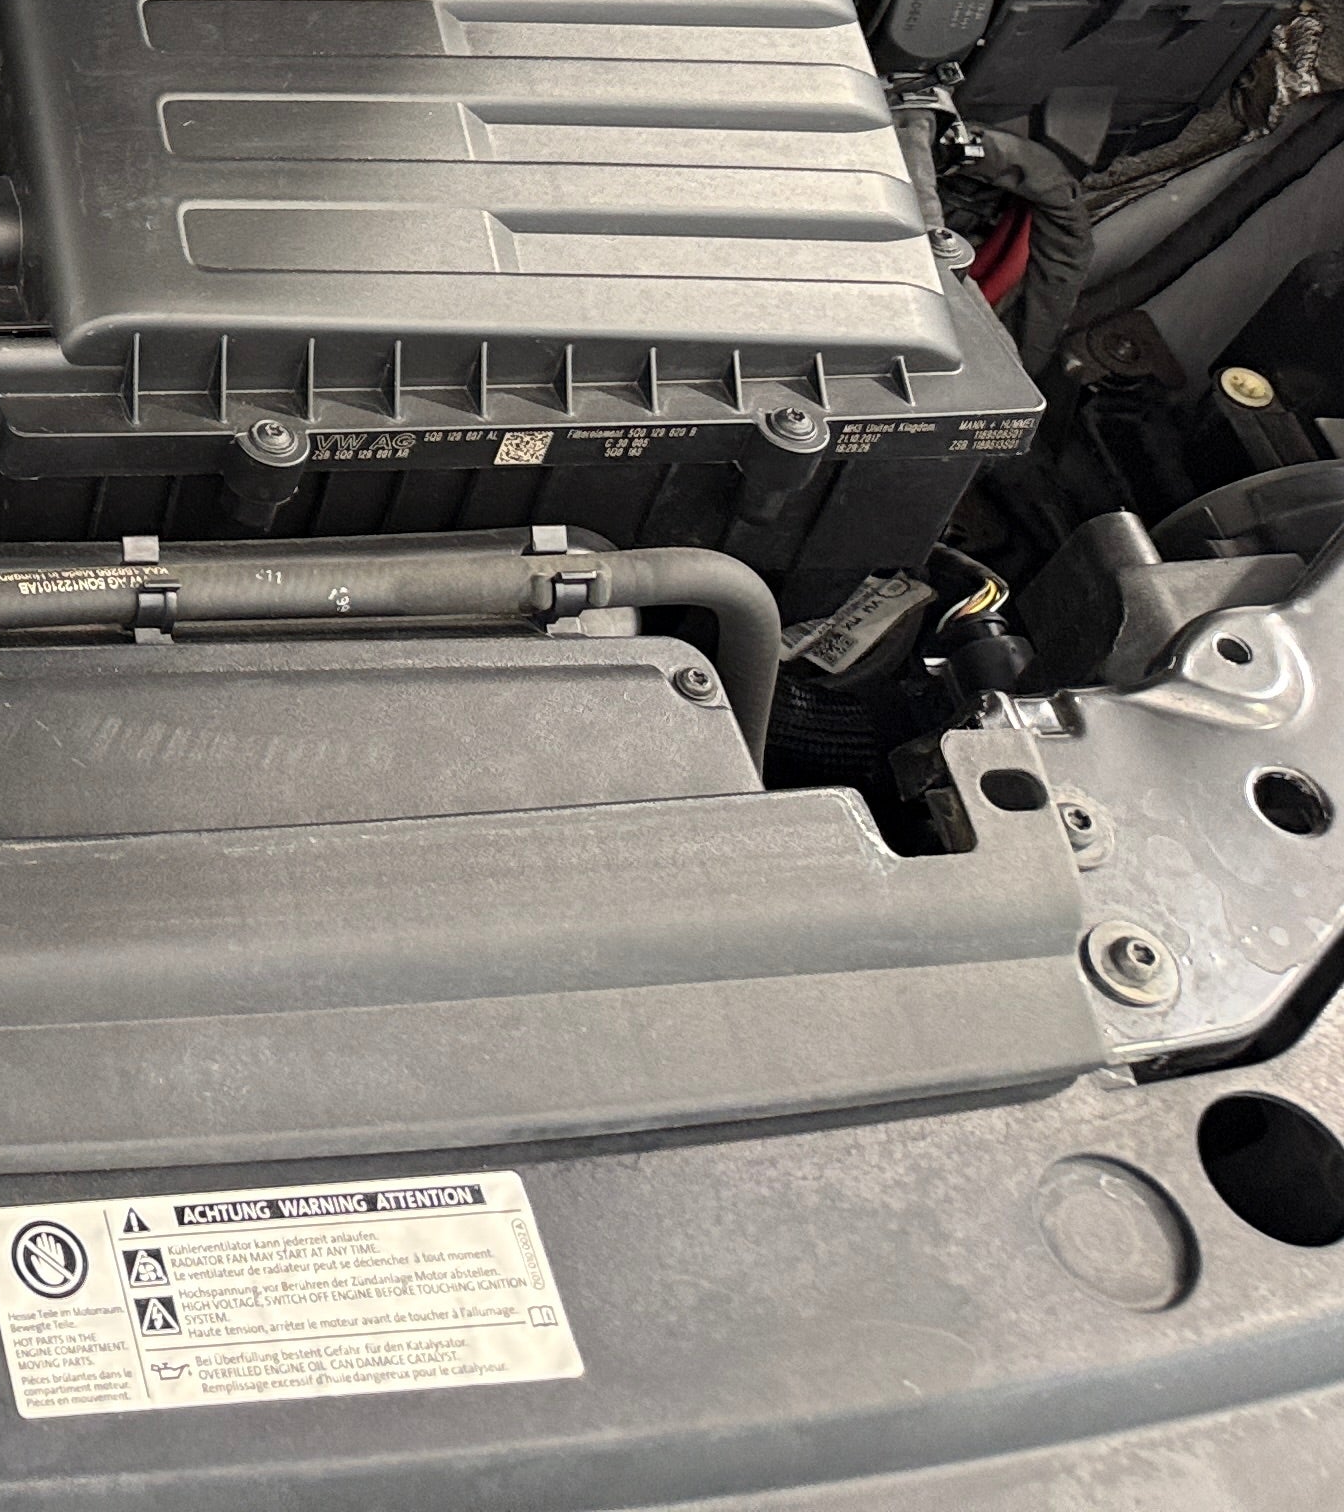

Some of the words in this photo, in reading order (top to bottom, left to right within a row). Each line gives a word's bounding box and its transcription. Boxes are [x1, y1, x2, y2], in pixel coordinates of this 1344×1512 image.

[315, 433, 367, 451] VW
[369, 432, 416, 450] AG
[183, 1201, 271, 1225] ACHTUNG
[277, 1193, 368, 1218] WARNING
[376, 1186, 474, 1211] ATTENTION
[167, 1240, 252, 1256] Kühlerventilator
[253, 1237, 280, 1250] kann
[282, 1234, 329, 1253] jederzeit
[330, 1231, 380, 1244] anlaufen.
[170, 1254, 224, 1268] RADIATOR
[226, 1252, 248, 1264] FAN
[250, 1250, 275, 1262] MAY
[275, 1247, 308, 1262] START
[310, 1246, 324, 1258] AT
[326, 1244, 348, 1257] ANY
[173, 1270, 186, 1281] Le
[187, 1266, 245, 1281] ventilateur
[247, 1265, 261, 1276] de
[263, 1262, 311, 1275] radiateur
[313, 1260, 337, 1274] peut
[339, 1260, 351, 1270] se
[422, 1251, 445, 1263] tout
[181, 1300, 211, 1312] HIGH
[265, 1293, 308, 1306] SWITCH
[309, 1291, 330, 1303] OFF
[332, 1287, 374, 1301] ENGINE
[375, 1284, 417, 1299] BEFORE
[418, 1280, 476, 1295] TOUCHING
[477, 1276, 528, 1290] IGNITION
[263, 1284, 279, 1294] vor
[332, 1277, 348, 1288] der
[414, 1269, 448, 1282] Motor
[188, 1326, 222, 1338] Haute
[307, 1318, 318, 1330] le
[319, 1316, 359, 1329] moteur
[361, 1314, 392, 1326] avant
[393, 1312, 407, 1323] de
[408, 1309, 450, 1322] toucher
[13, 1337, 34, 1348] HOT
[35, 1334, 64, 1346] PARTS
[65, 1334, 77, 1344] IN
[77, 1332, 97, 1343] THE
[15, 1347, 53, 1359] ENGINE
[18, 1358, 61, 1370] MOVING
[194, 1355, 212, 1367] Bei
[280, 1347, 323, 1361] besteht
[323, 1344, 361, 1357] Gefahr
[383, 1340, 405, 1352] den
[198, 1365, 262, 1380] OVERFILLED
[264, 1362, 305, 1376] ENGINE
[307, 1359, 327, 1372] OIL
[330, 1357, 354, 1370] CAN
[355, 1353, 406, 1369] DAMAGE
[202, 1378, 269, 1395] Remplissage
[271, 1375, 314, 1388] excessif
[352, 1369, 411, 1385] dangereux
[412, 1366, 438, 1381] pour
[438, 1365, 450, 1376] le
